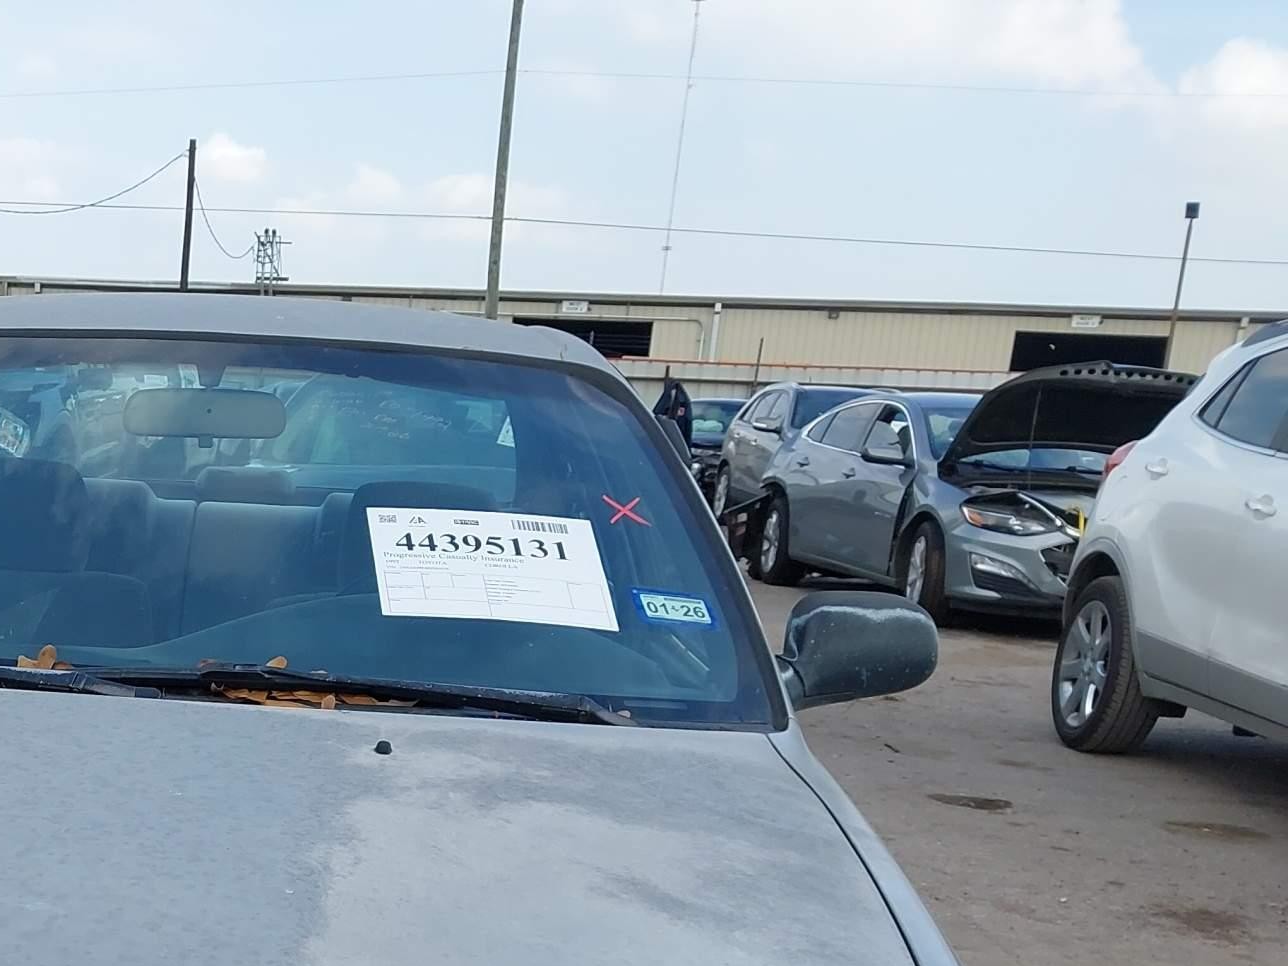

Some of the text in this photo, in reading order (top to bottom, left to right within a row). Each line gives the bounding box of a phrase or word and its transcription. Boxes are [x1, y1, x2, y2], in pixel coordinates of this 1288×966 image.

[395, 532, 571, 560] 44395131
[383, 551, 436, 560] Progressive
[481, 555, 525, 564] Insurance
